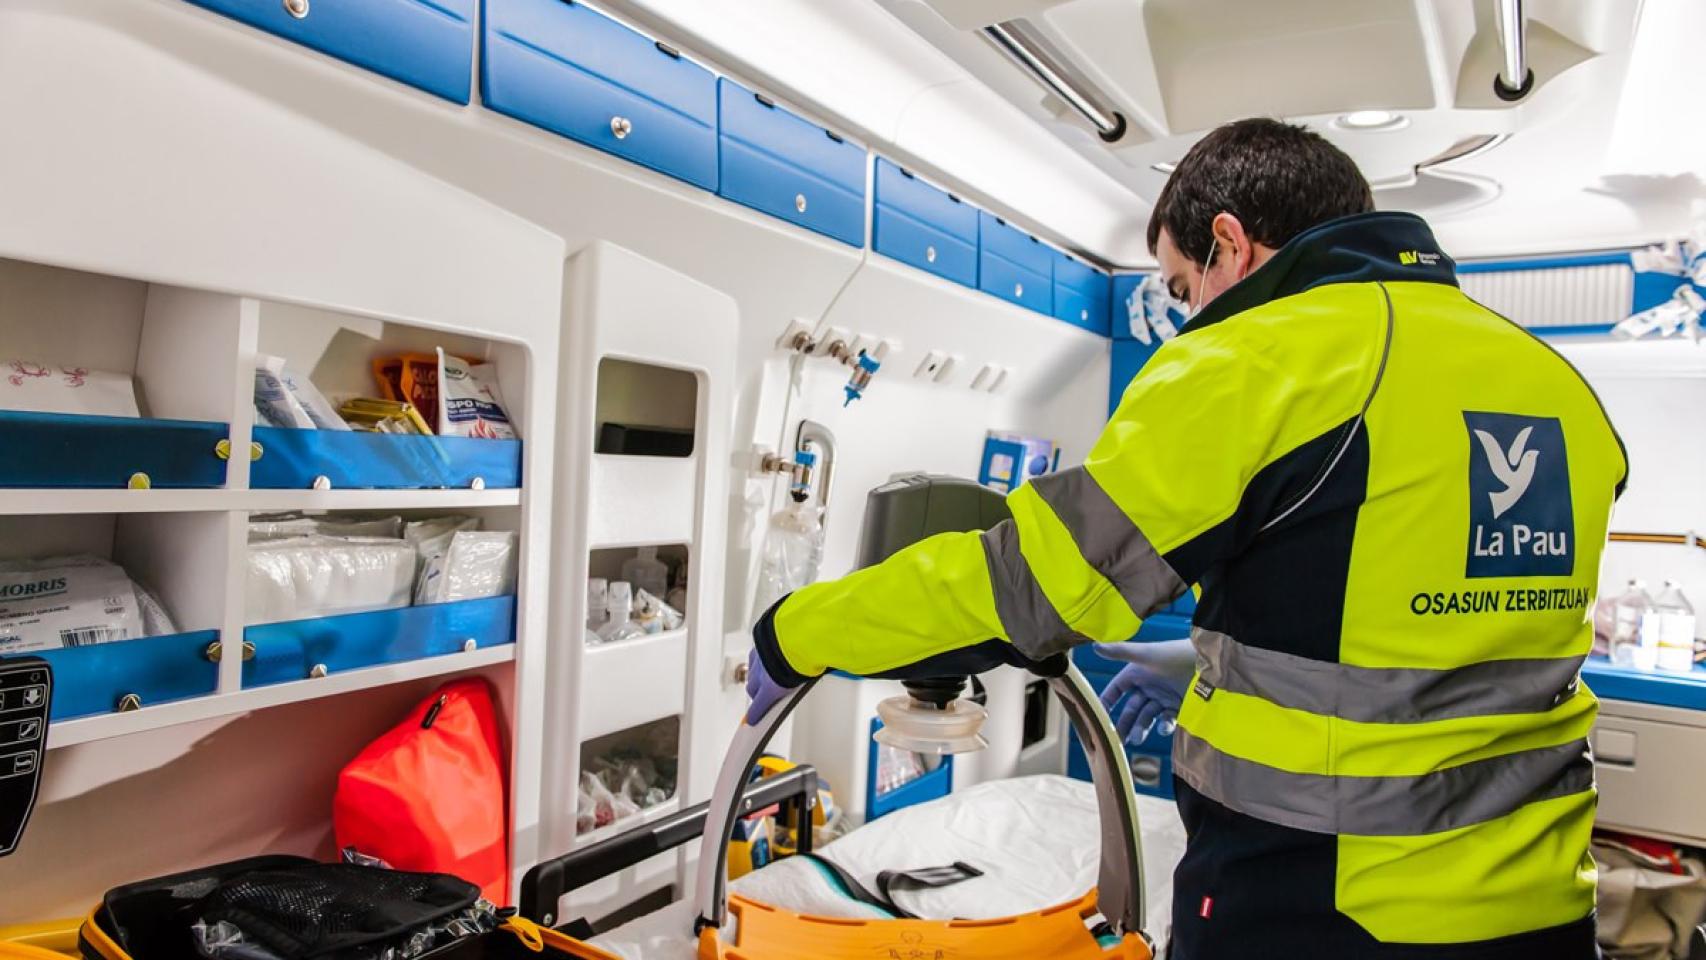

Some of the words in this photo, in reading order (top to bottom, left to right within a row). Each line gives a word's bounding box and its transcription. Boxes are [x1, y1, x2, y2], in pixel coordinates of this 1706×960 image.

[1474, 525, 1504, 557] La
[1512, 525, 1566, 556] Pau
[1410, 590, 1500, 615] OSASUN
[1505, 587, 1590, 612] ZERBITZUAK
